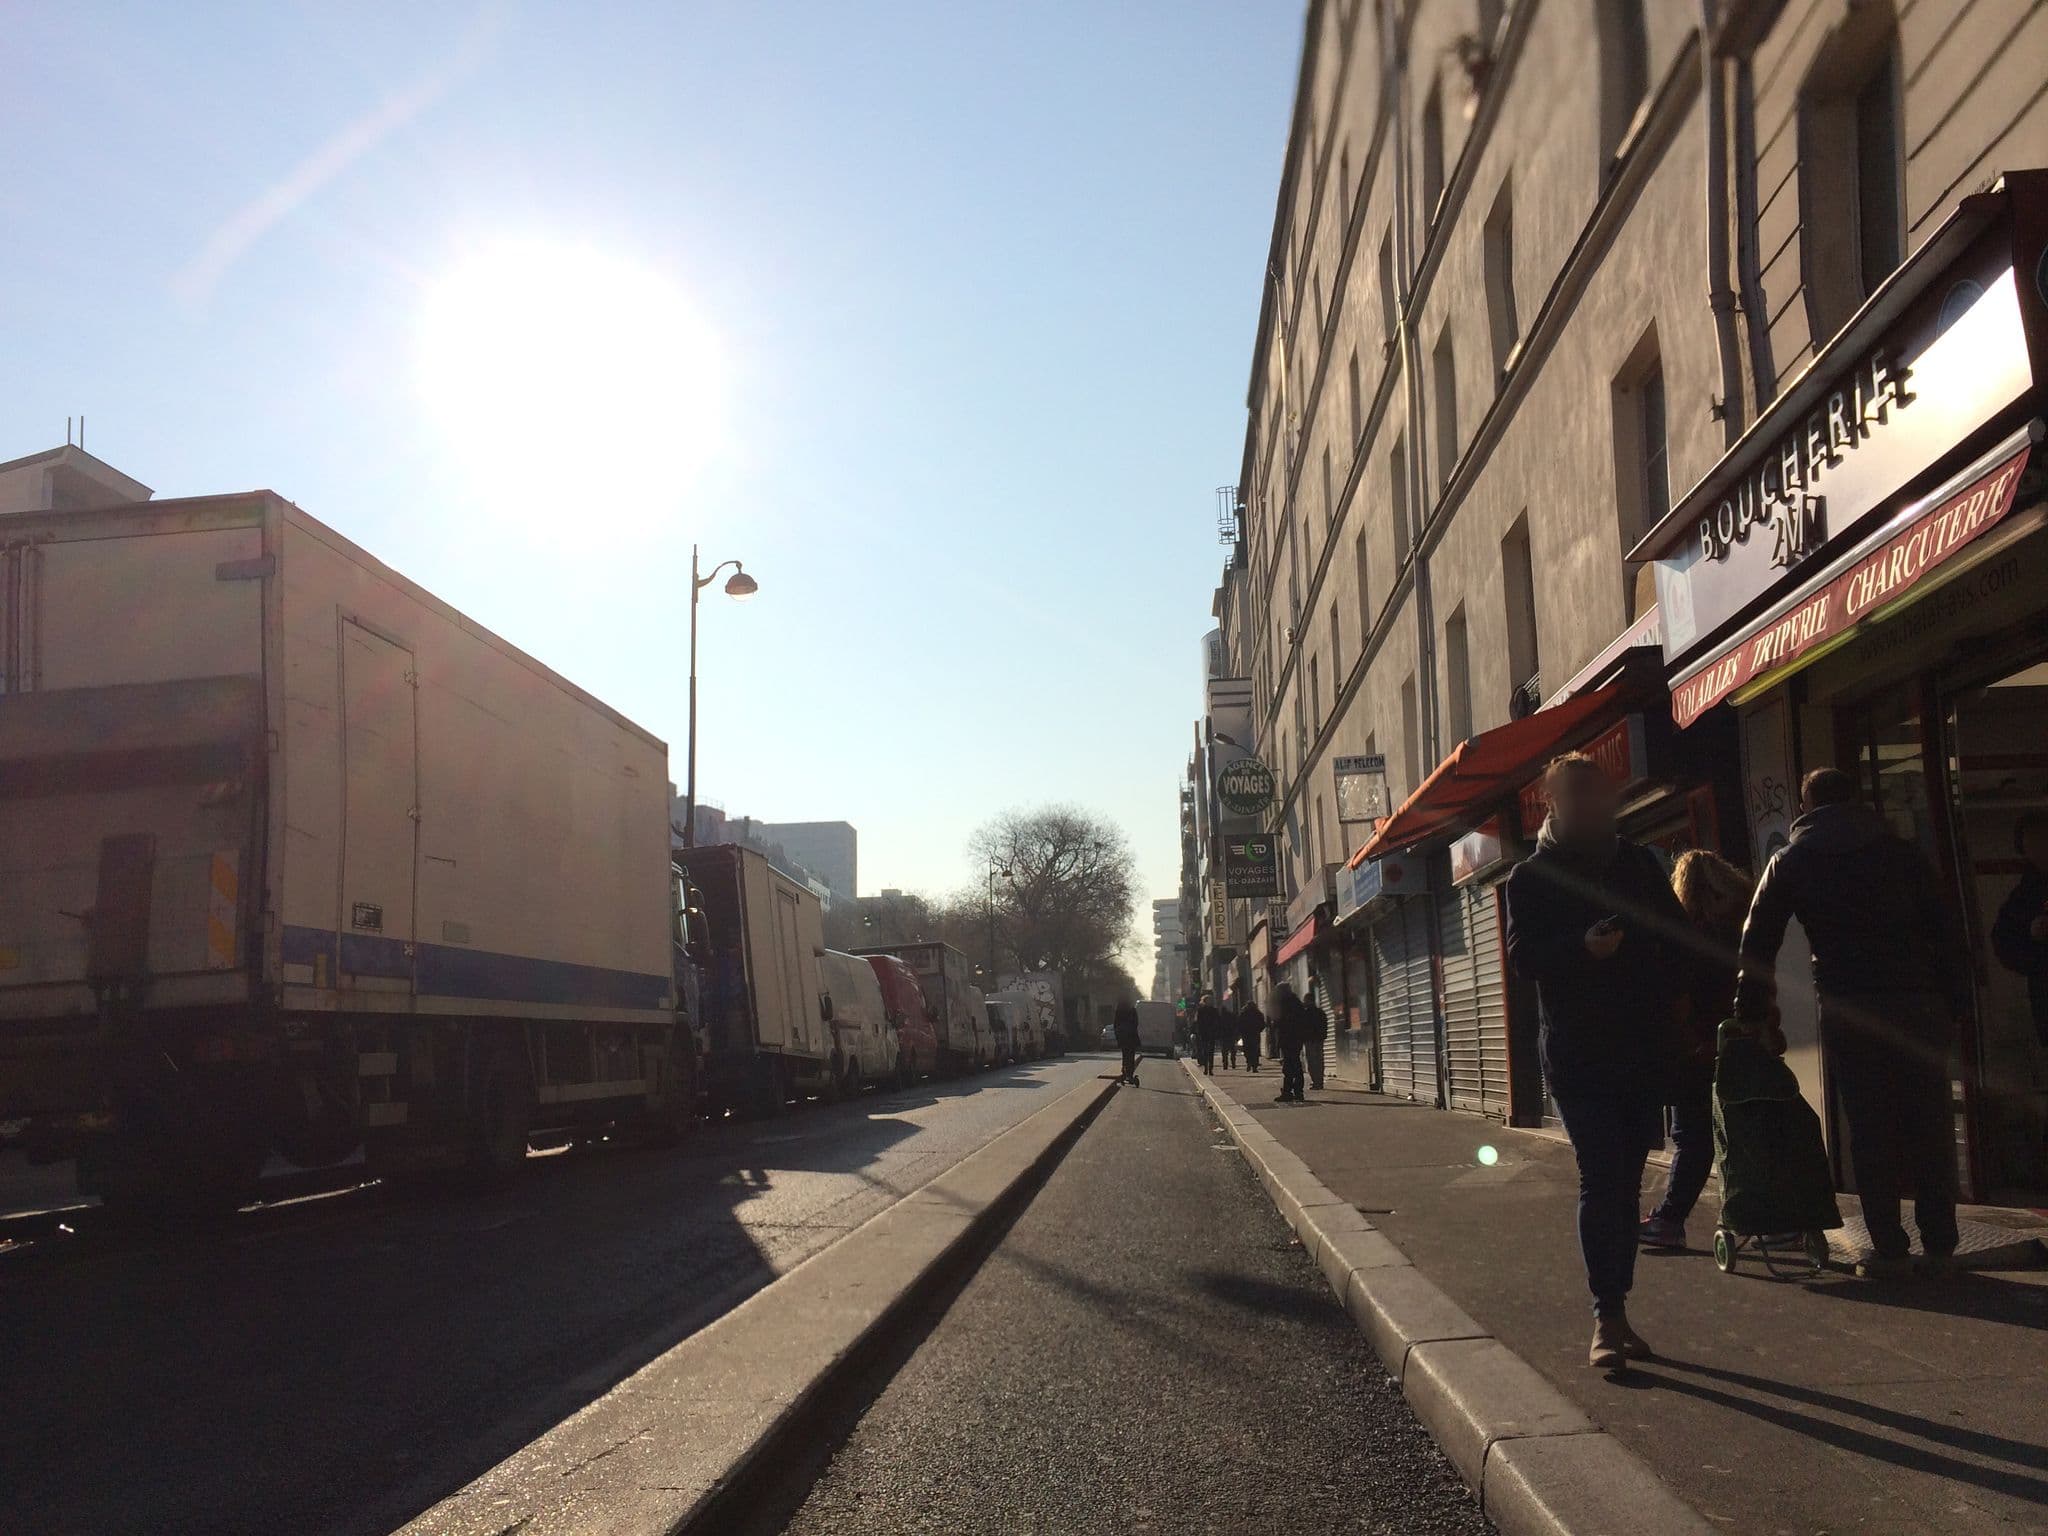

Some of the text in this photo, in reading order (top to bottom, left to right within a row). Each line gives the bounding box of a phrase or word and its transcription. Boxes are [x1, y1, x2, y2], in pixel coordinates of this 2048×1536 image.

[1701, 348, 1894, 562] BOUCHERIE
[1675, 652, 1742, 724] VOLAILLES
[1749, 594, 1830, 673] TRIPERIE
[1846, 467, 2015, 616] CHARCUTERIE
[1224, 775, 1270, 794] VOYAGES
[1228, 866, 1274, 875] VOYAGES
